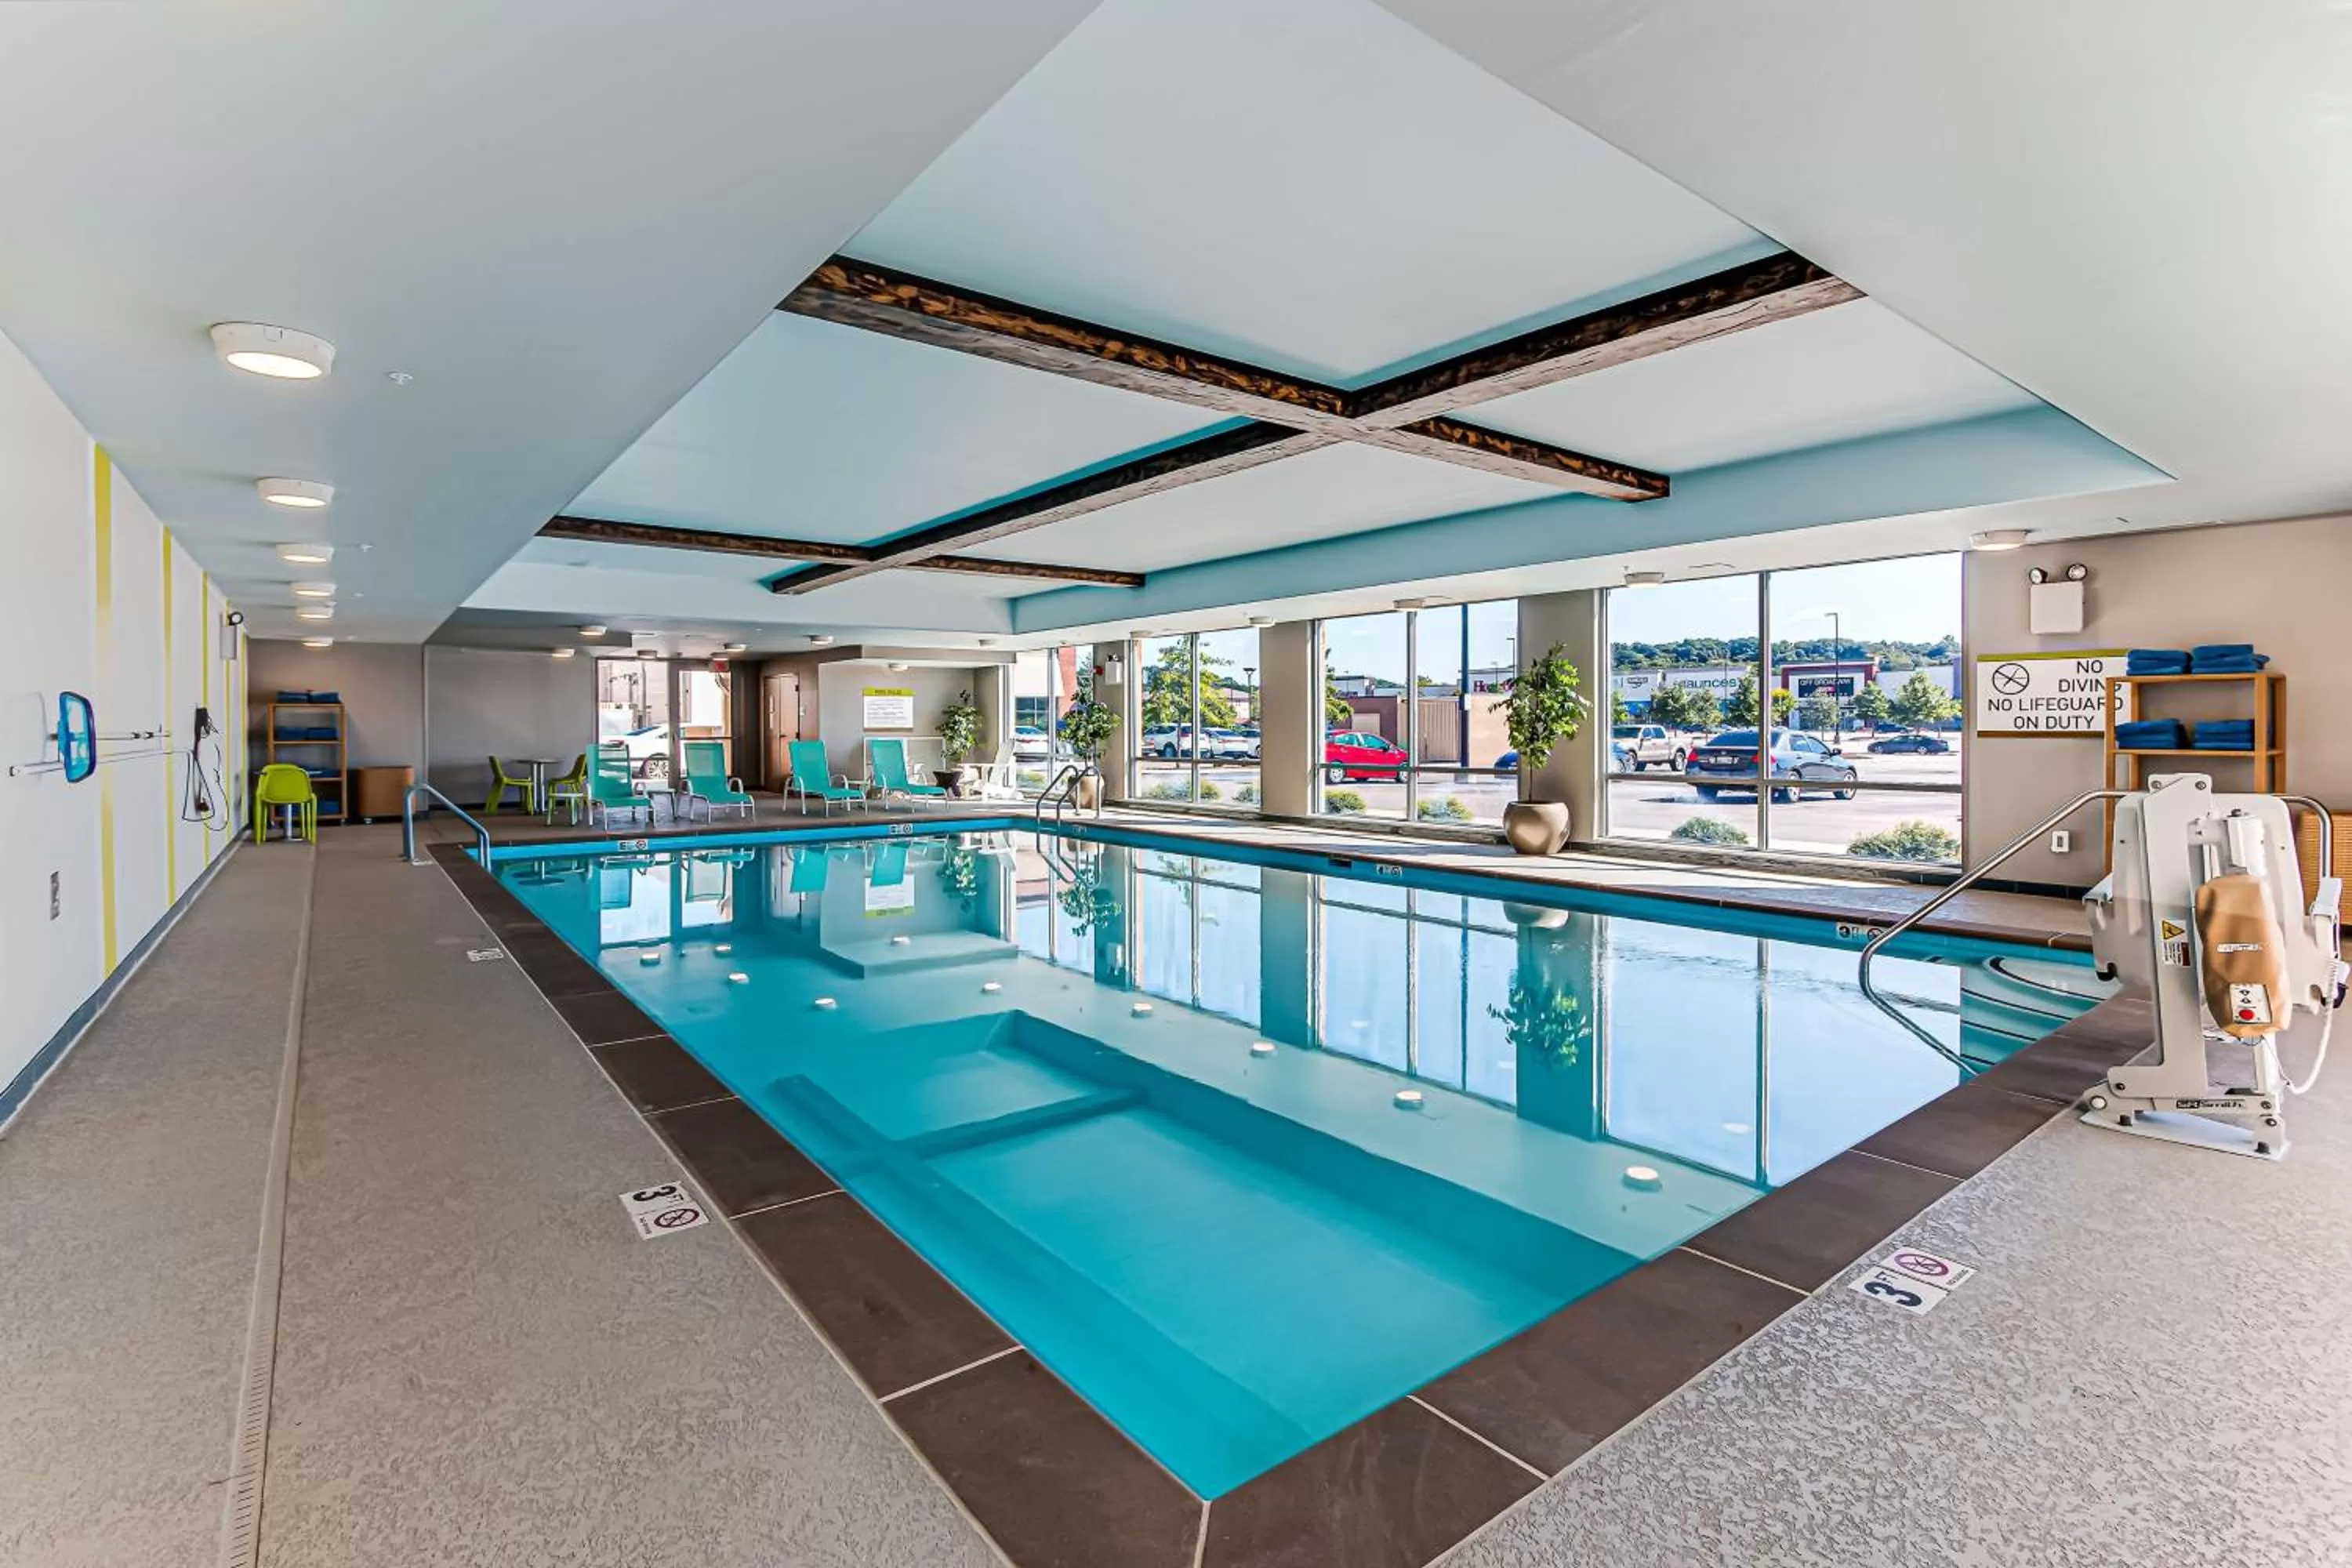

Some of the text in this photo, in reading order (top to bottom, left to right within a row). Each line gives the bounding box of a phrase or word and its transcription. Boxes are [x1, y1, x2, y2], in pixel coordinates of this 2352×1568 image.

[2077, 659, 2103, 673] NO
[1987, 697, 2124, 711] NO LIFEGUARD
[2013, 716, 2094, 729] ON DUTY
[632, 1185, 677, 1201] 3
[1864, 1282, 1922, 1306] 3
